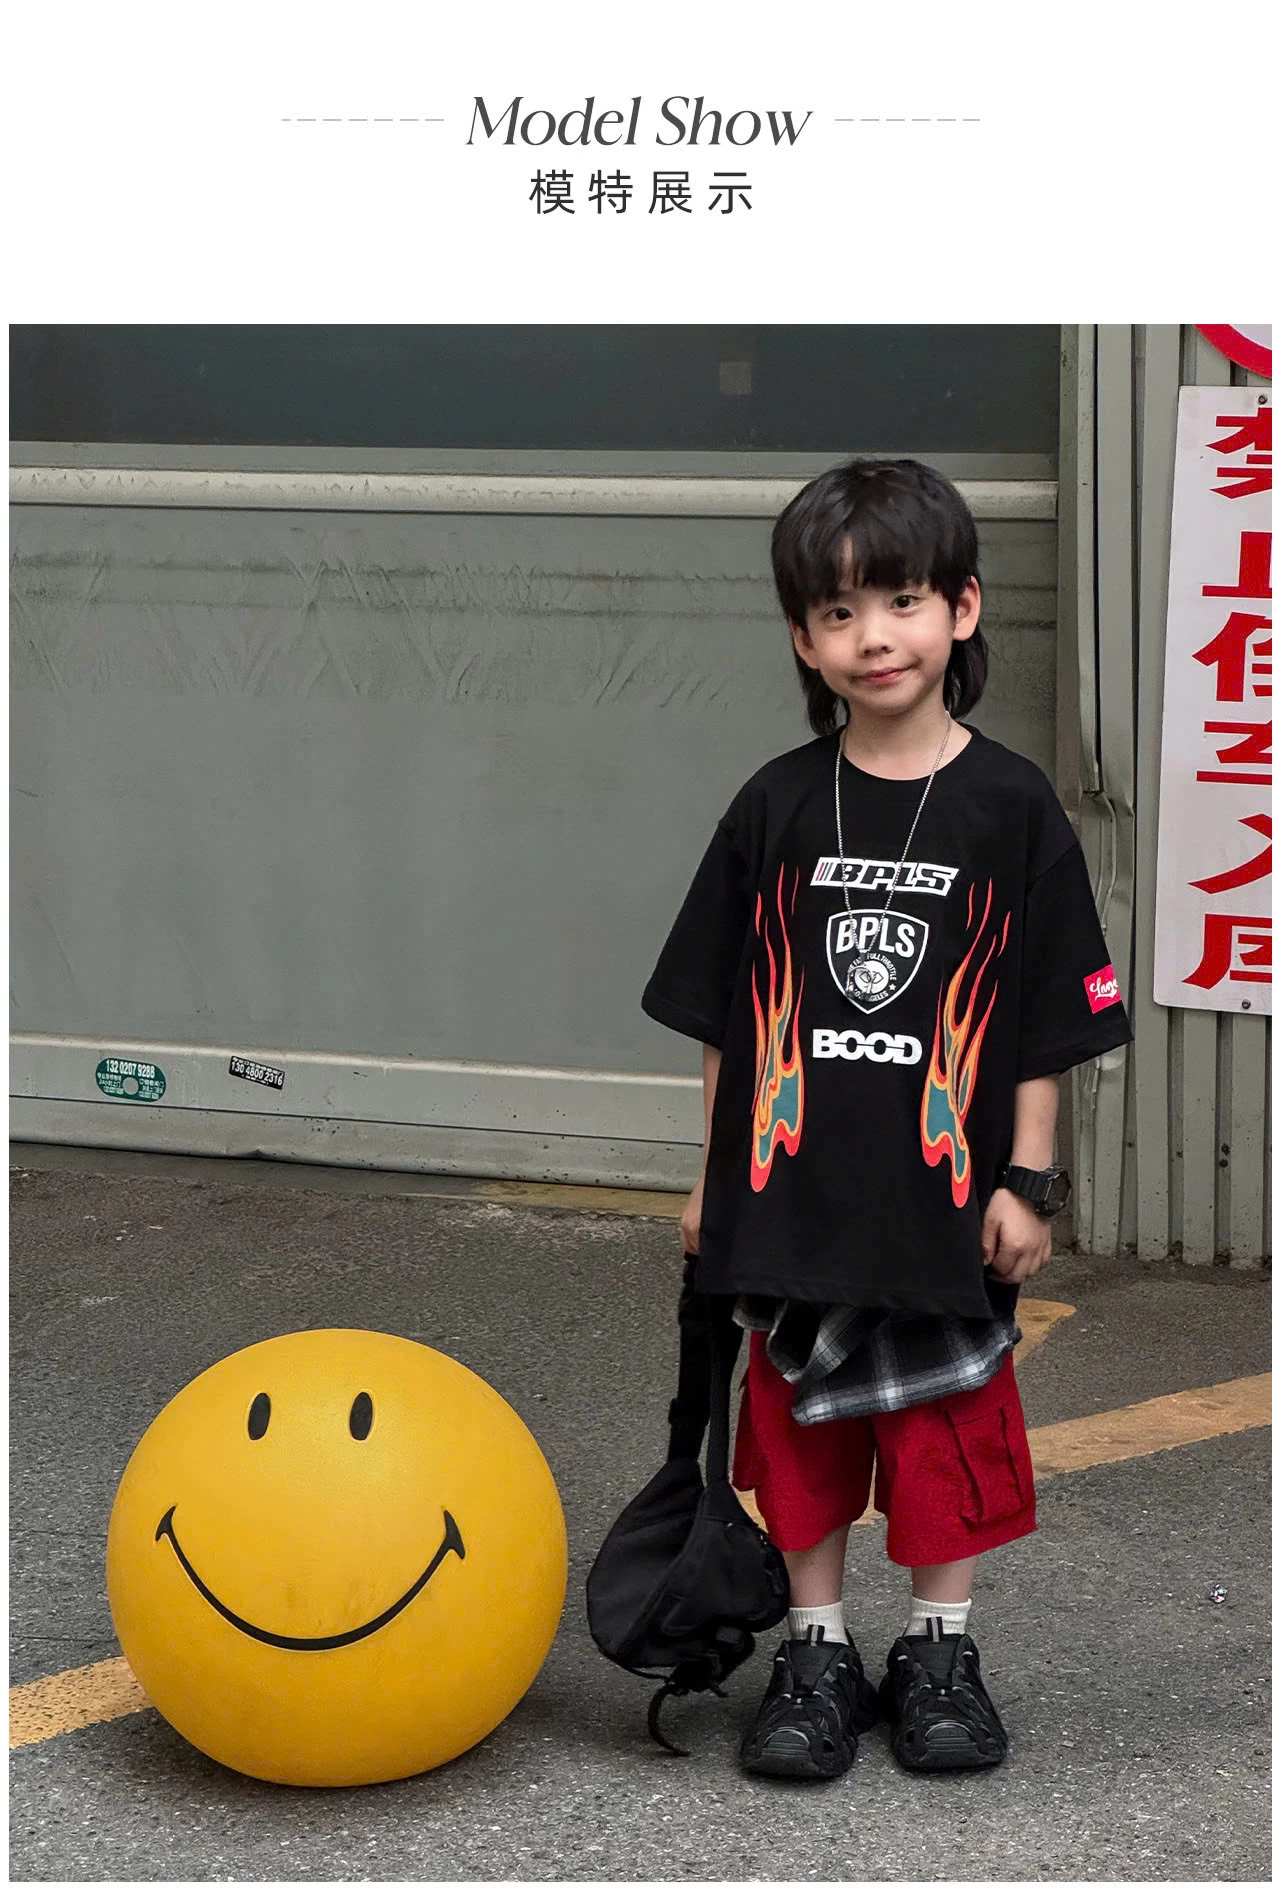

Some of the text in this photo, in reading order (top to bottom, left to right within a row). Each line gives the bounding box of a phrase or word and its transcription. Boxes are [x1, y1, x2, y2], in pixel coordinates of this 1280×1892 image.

[828, 859, 957, 894] BPLS
[836, 917, 916, 958] BPLS
[813, 1029, 922, 1064] BOOD
[106, 1059, 119, 1073] 132
[119, 1061, 138, 1076] 0207
[231, 1061, 245, 1074] 130
